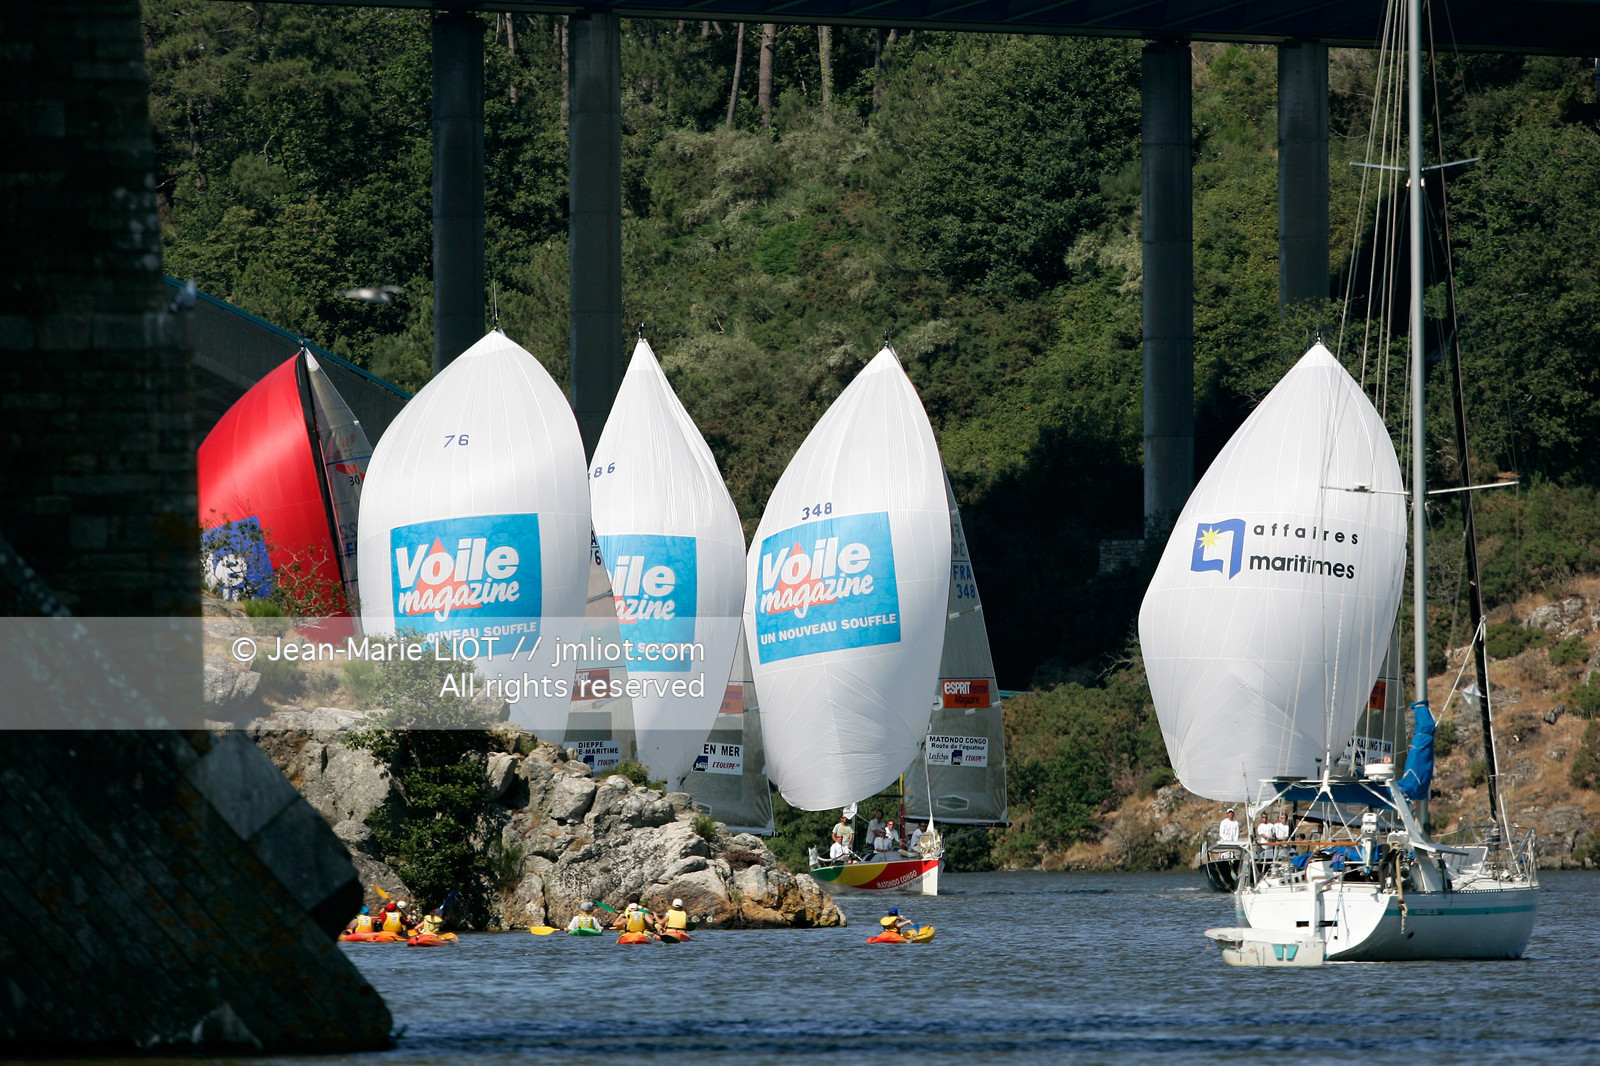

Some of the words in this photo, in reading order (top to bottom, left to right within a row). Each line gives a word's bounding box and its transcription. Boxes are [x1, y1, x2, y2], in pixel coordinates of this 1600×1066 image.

[443, 434, 469, 448] 76
[349, 475, 360, 486] 30
[802, 502, 832, 520] 348
[1253, 523, 1358, 545] affaires
[395, 537, 520, 589] Voile
[763, 536, 871, 591] Voile
[953, 565, 972, 580] FRA
[1250, 554, 1355, 579] maritimes
[610, 555, 676, 597] ile
[398, 577, 520, 622] magazine
[760, 572, 874, 618] magazine
[956, 584, 976, 599] 348
[615, 594, 676, 620] azine
[426, 626, 479, 644] OUVEAU
[483, 621, 537, 637] SOUFFLE
[760, 632, 776, 645] UN
[779, 620, 837, 641] NOUVEAU
[841, 613, 897, 630] SOUFFLE
[703, 743, 716, 754] EN
[721, 745, 740, 757] MER
[929, 736, 964, 744] MATONDO
[965, 737, 987, 745] CONGO
[1357, 738, 1378, 751] SAIING
[577, 747, 619, 755] E-MARITIME
[876, 877, 900, 888] MATONDO
[900, 869, 918, 884] CONGO
